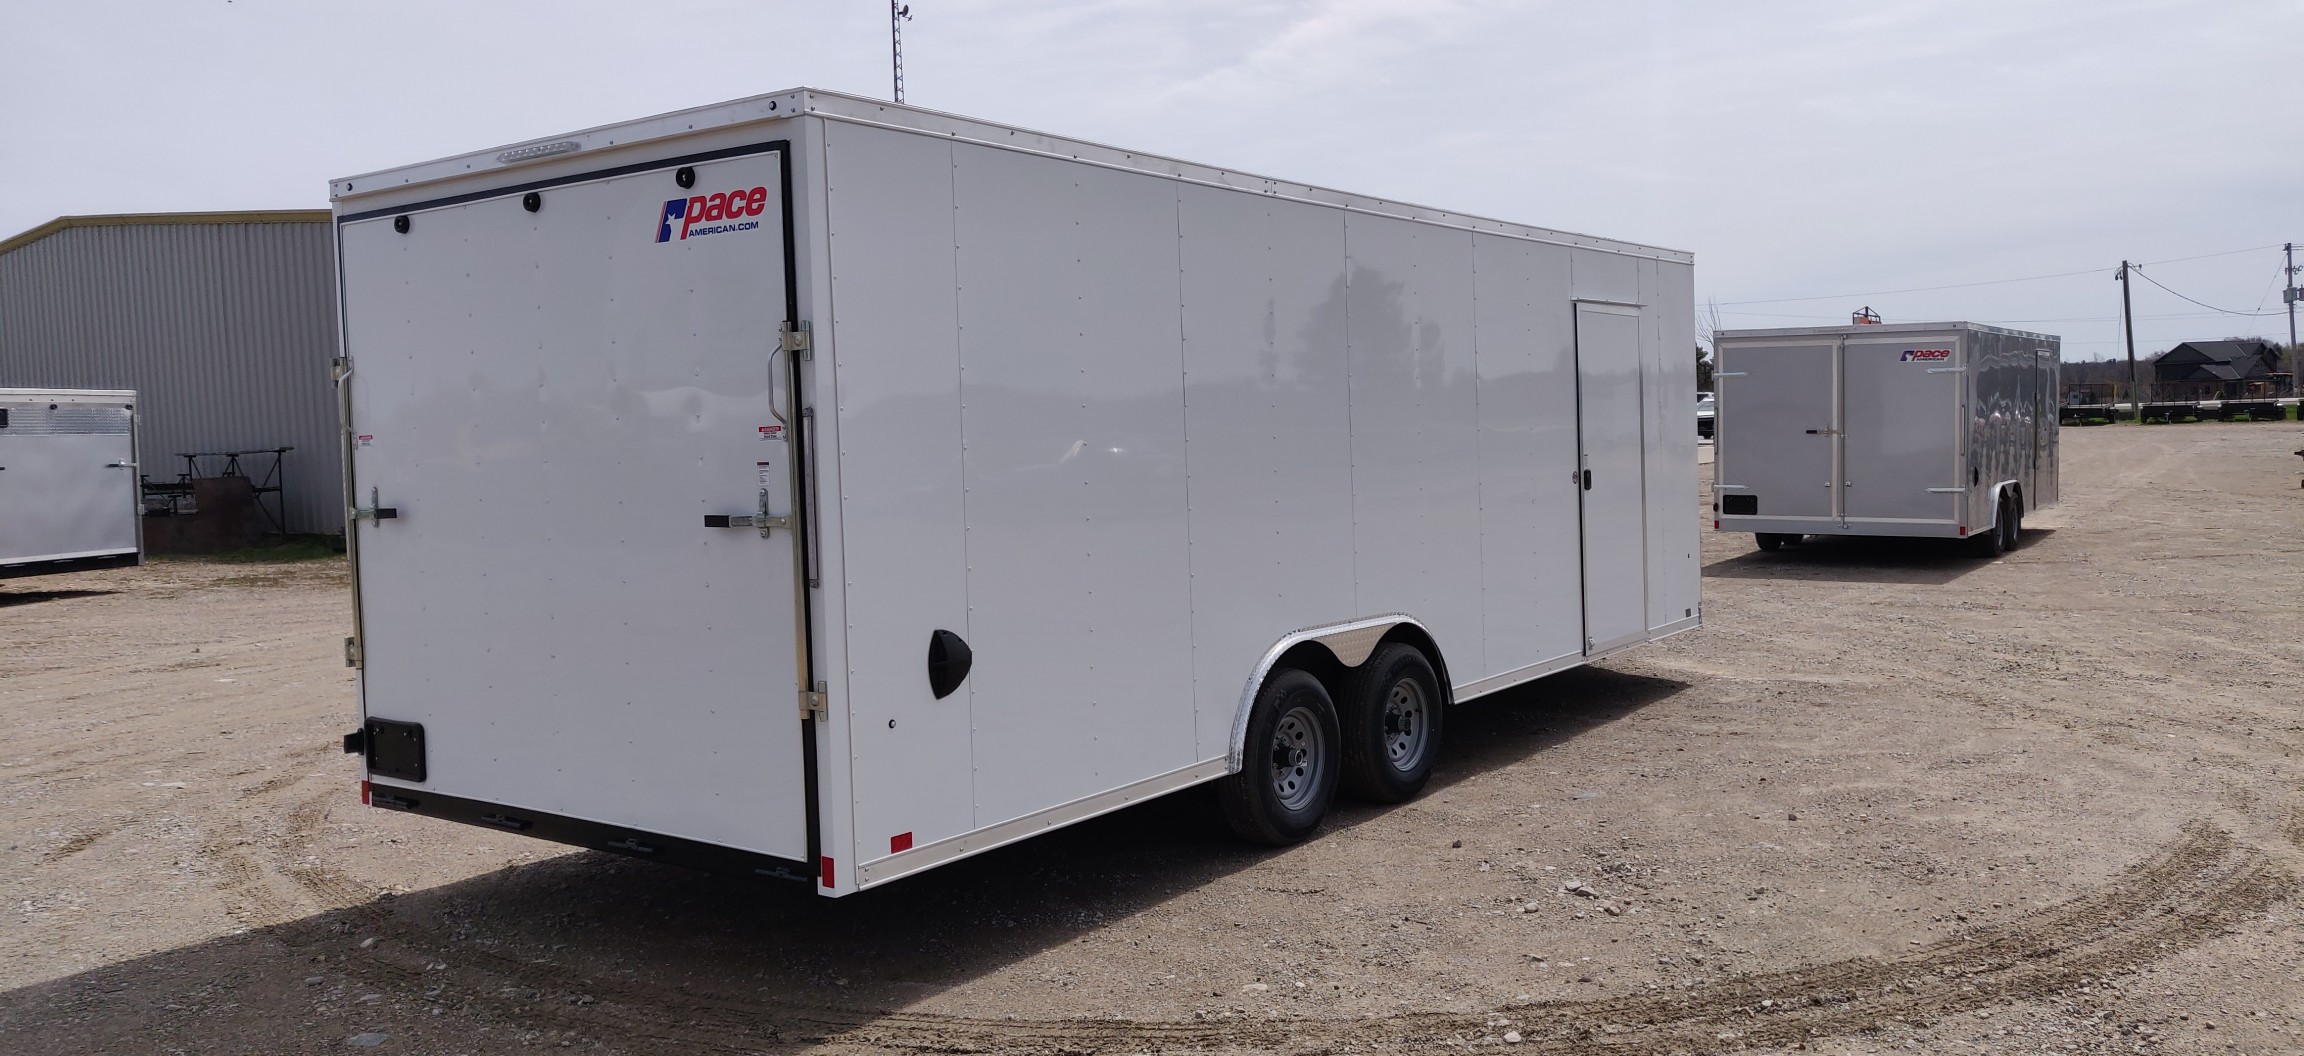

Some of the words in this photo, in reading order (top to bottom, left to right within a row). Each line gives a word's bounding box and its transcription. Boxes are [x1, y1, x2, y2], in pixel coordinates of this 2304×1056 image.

[680, 186, 768, 240] pace
[688, 221, 759, 238] AMERICAN.COM
[1911, 349, 1951, 362] pace
